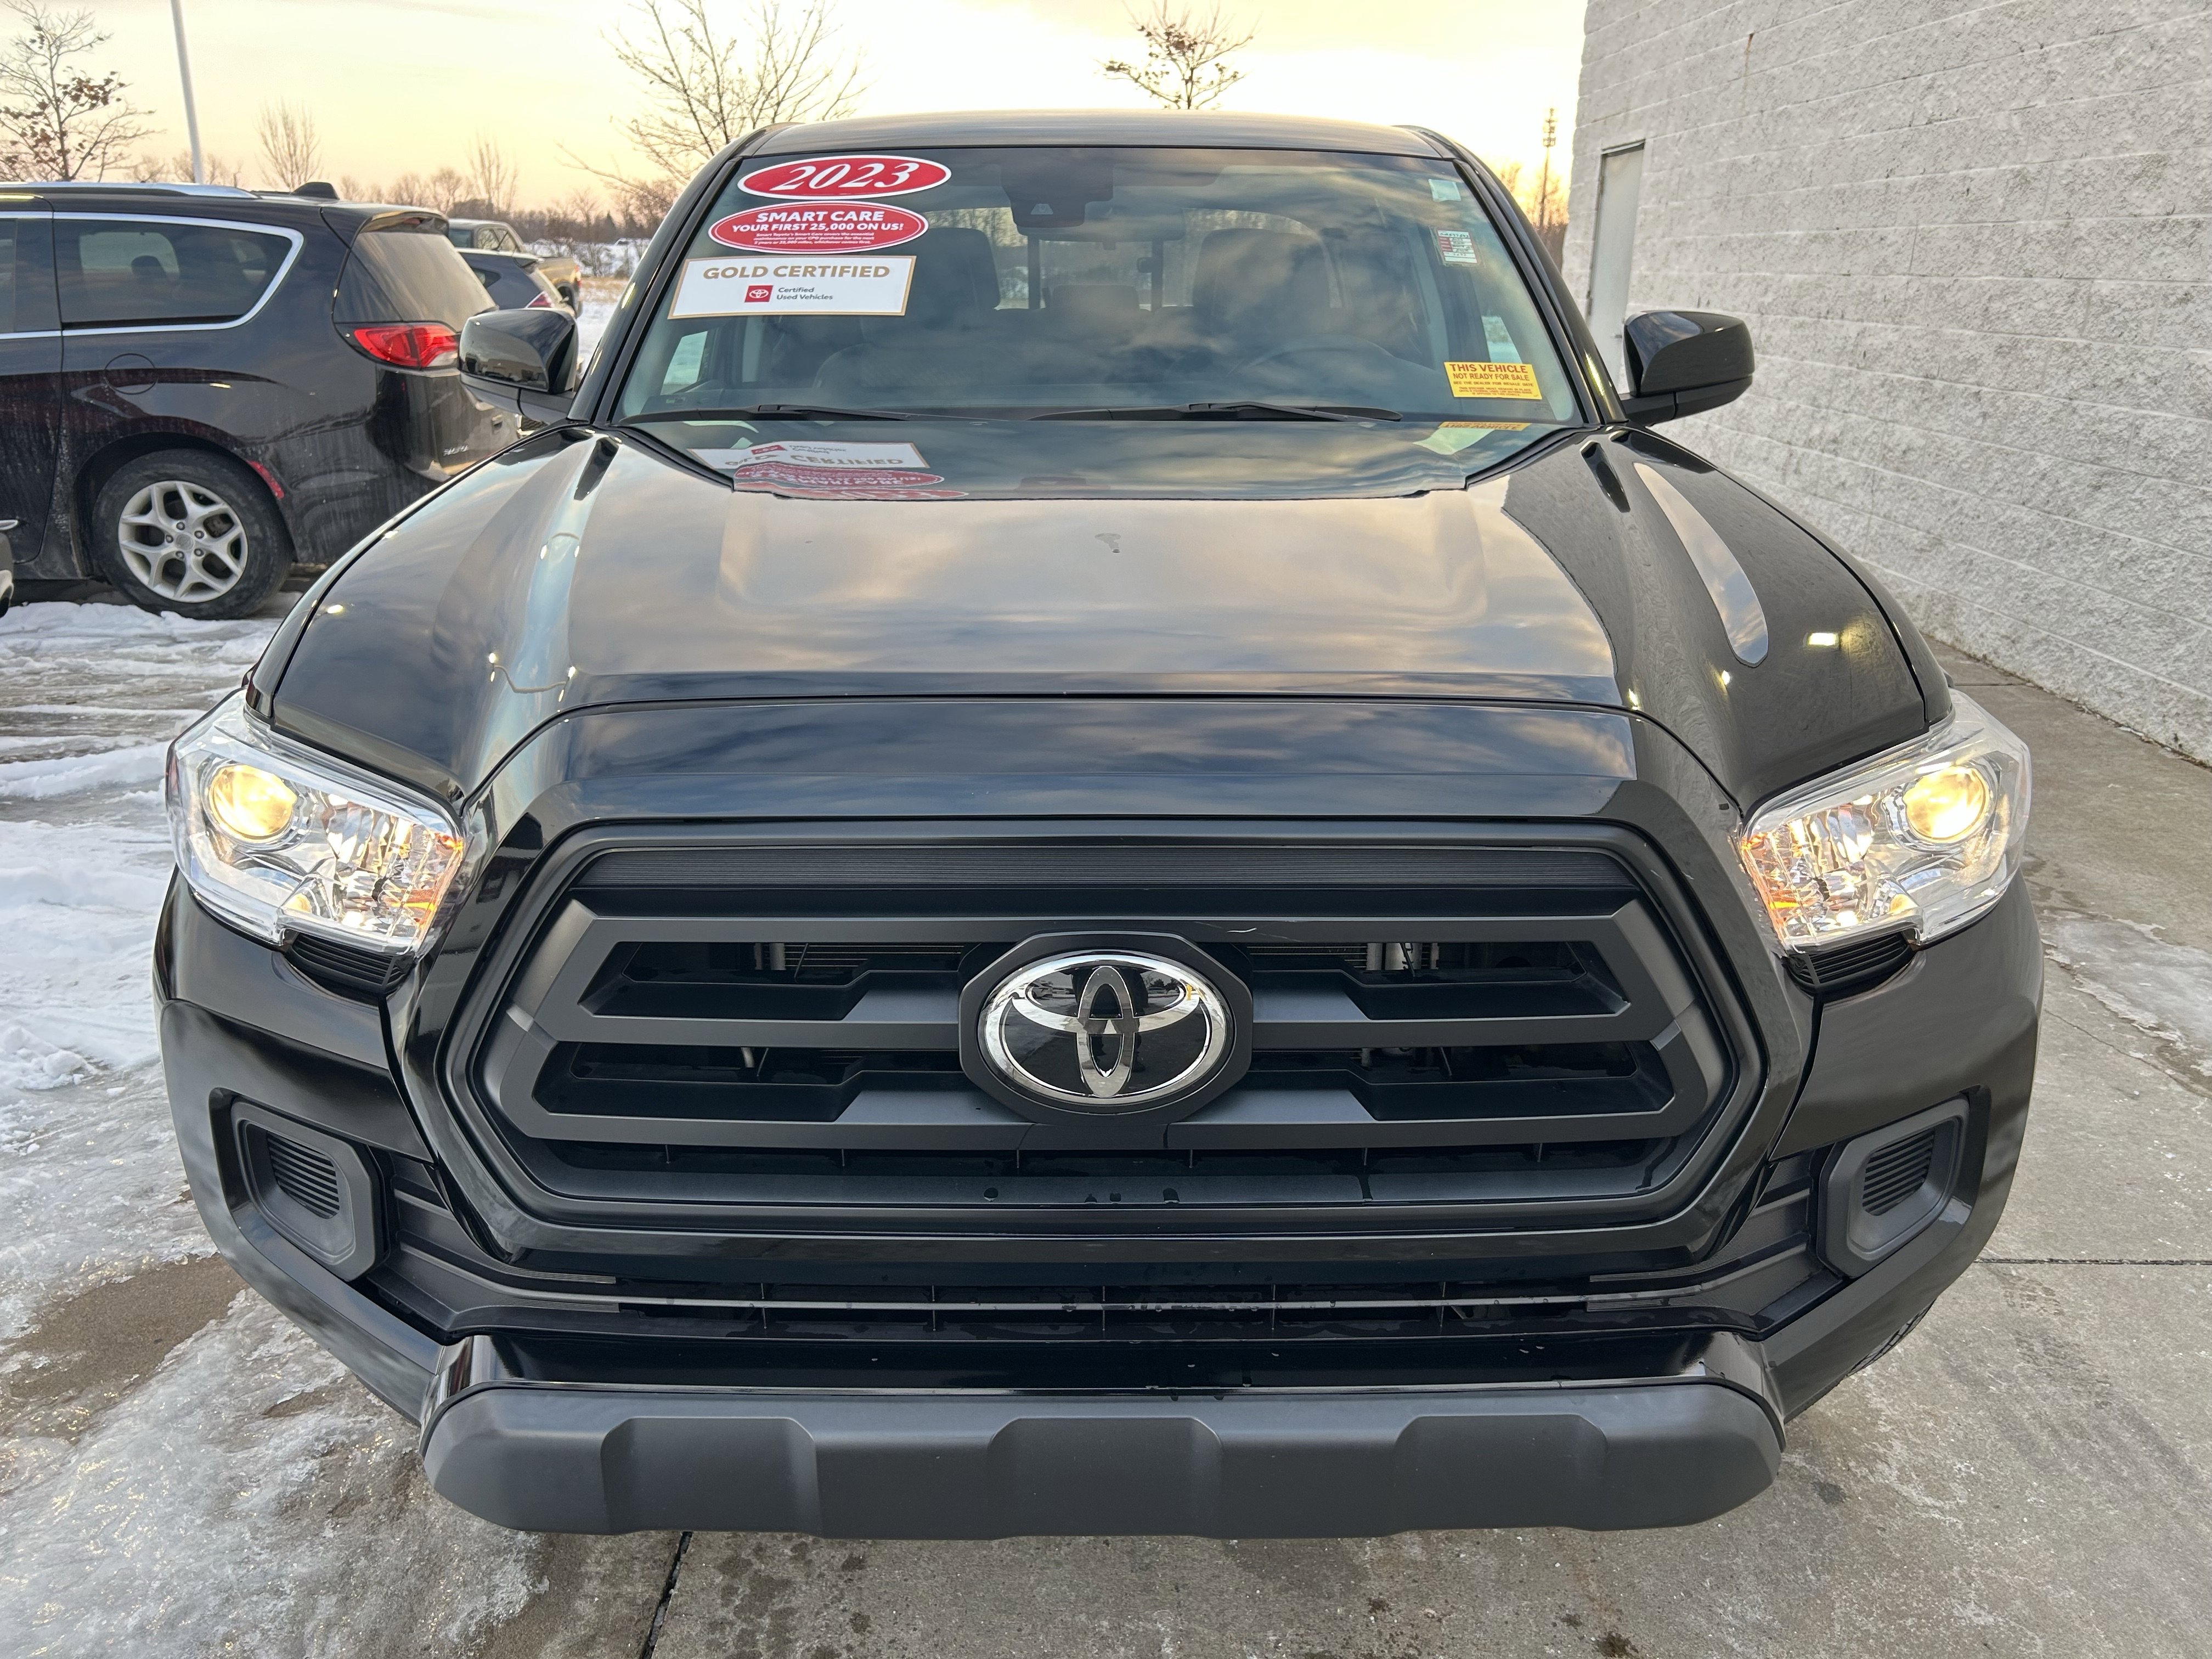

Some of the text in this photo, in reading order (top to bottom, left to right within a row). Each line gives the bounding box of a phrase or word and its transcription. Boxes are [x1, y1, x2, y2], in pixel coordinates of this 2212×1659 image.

[769, 162, 920, 190] 2023
[756, 211, 885, 222] SMART CARE
[732, 224, 769, 232] YOUR
[809, 223, 854, 232] 25,000
[881, 223, 904, 231] US!
[703, 266, 890, 279] GOLD CERTIFIED
[1449, 364, 1528, 373] THIS VEHICLE
